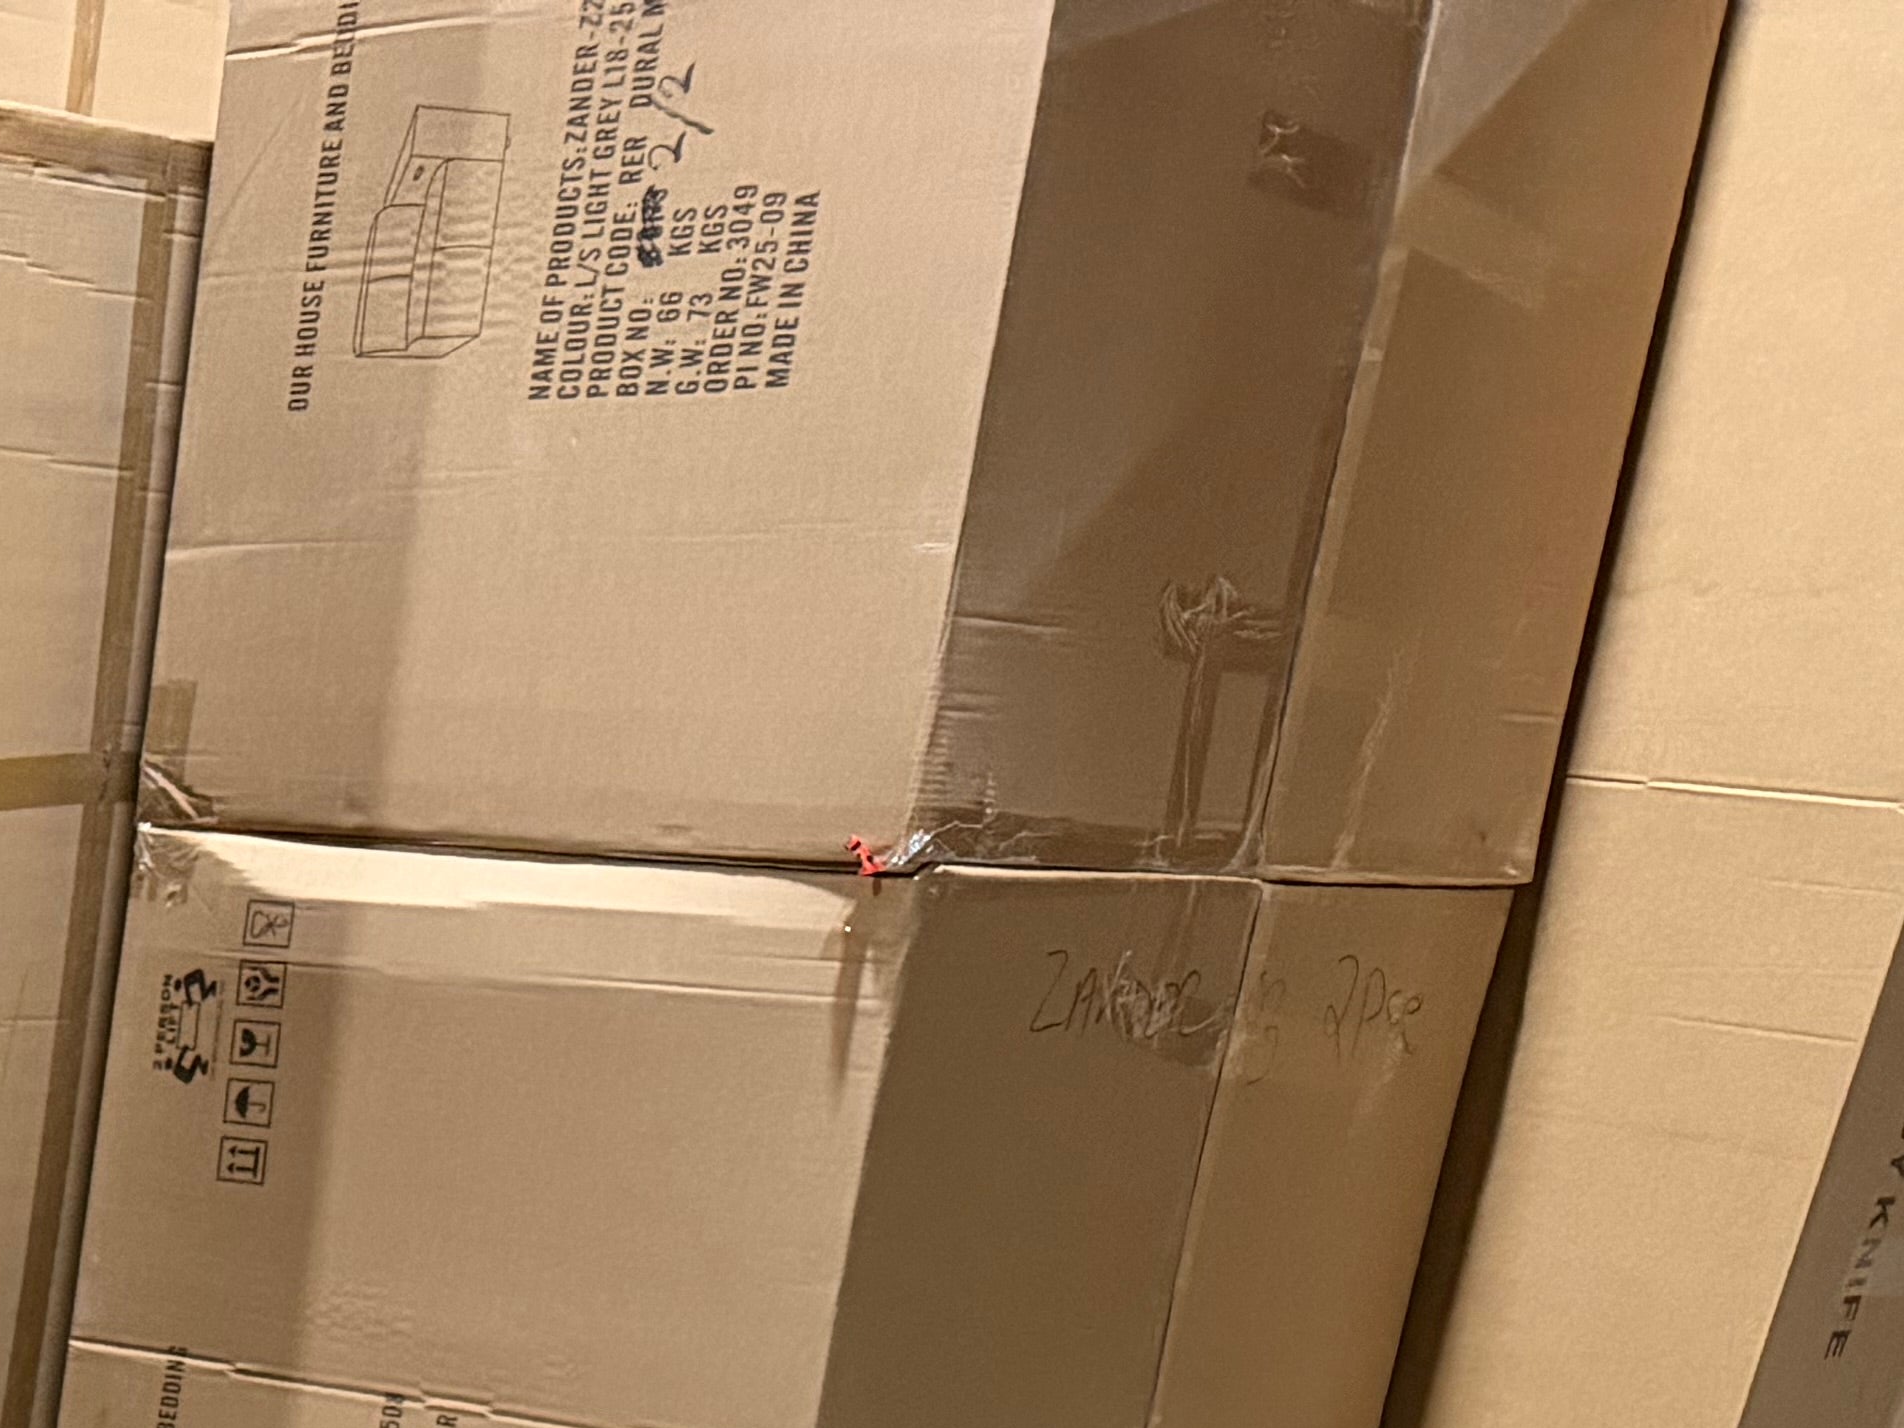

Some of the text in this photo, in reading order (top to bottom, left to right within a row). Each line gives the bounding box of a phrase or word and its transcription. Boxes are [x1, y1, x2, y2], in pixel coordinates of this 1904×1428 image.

[593, 97, 623, 160] GREY
[288, 84, 349, 412] OUR HOUSE FURNITURE AND
[581, 168, 613, 239] LIGHT
[586, 23, 664, 398] PRODUCT CODE: RER DURAL
[625, 298, 654, 341] NO:
[645, 207, 698, 395] N.W: 66 KGS
[675, 204, 728, 395] G.W: 73 KGS
[765, 190, 821, 388] MADE IN CHINA
[528, 295, 565, 400] NAME OF
[616, 348, 645, 397] BOX
[704, 308, 739, 394] ORDER
[733, 365, 759, 390] PI
